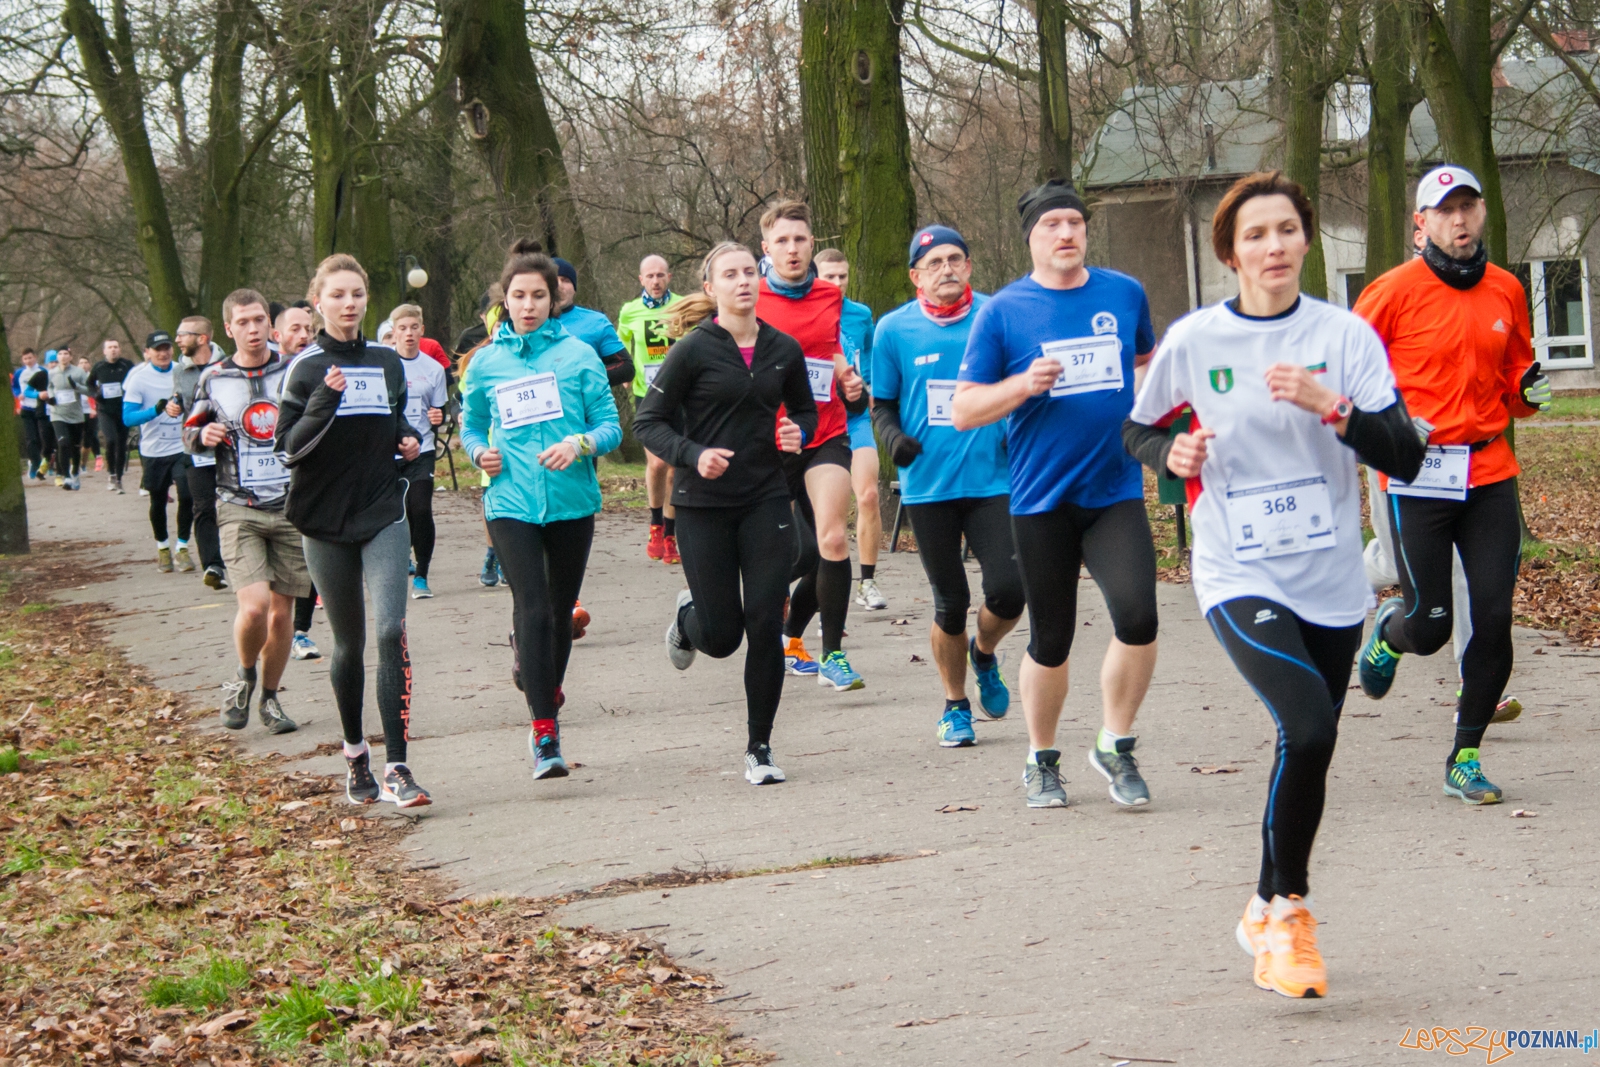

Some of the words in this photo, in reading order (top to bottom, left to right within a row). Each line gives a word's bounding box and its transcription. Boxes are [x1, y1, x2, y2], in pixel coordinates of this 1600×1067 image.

[1071, 352, 1094, 366] 377
[808, 369, 820, 380] 93
[354, 380, 367, 390] 29
[516, 389, 537, 403] 381
[257, 457, 276, 467] 973
[1422, 457, 1442, 469] 98
[1262, 495, 1297, 516] 368
